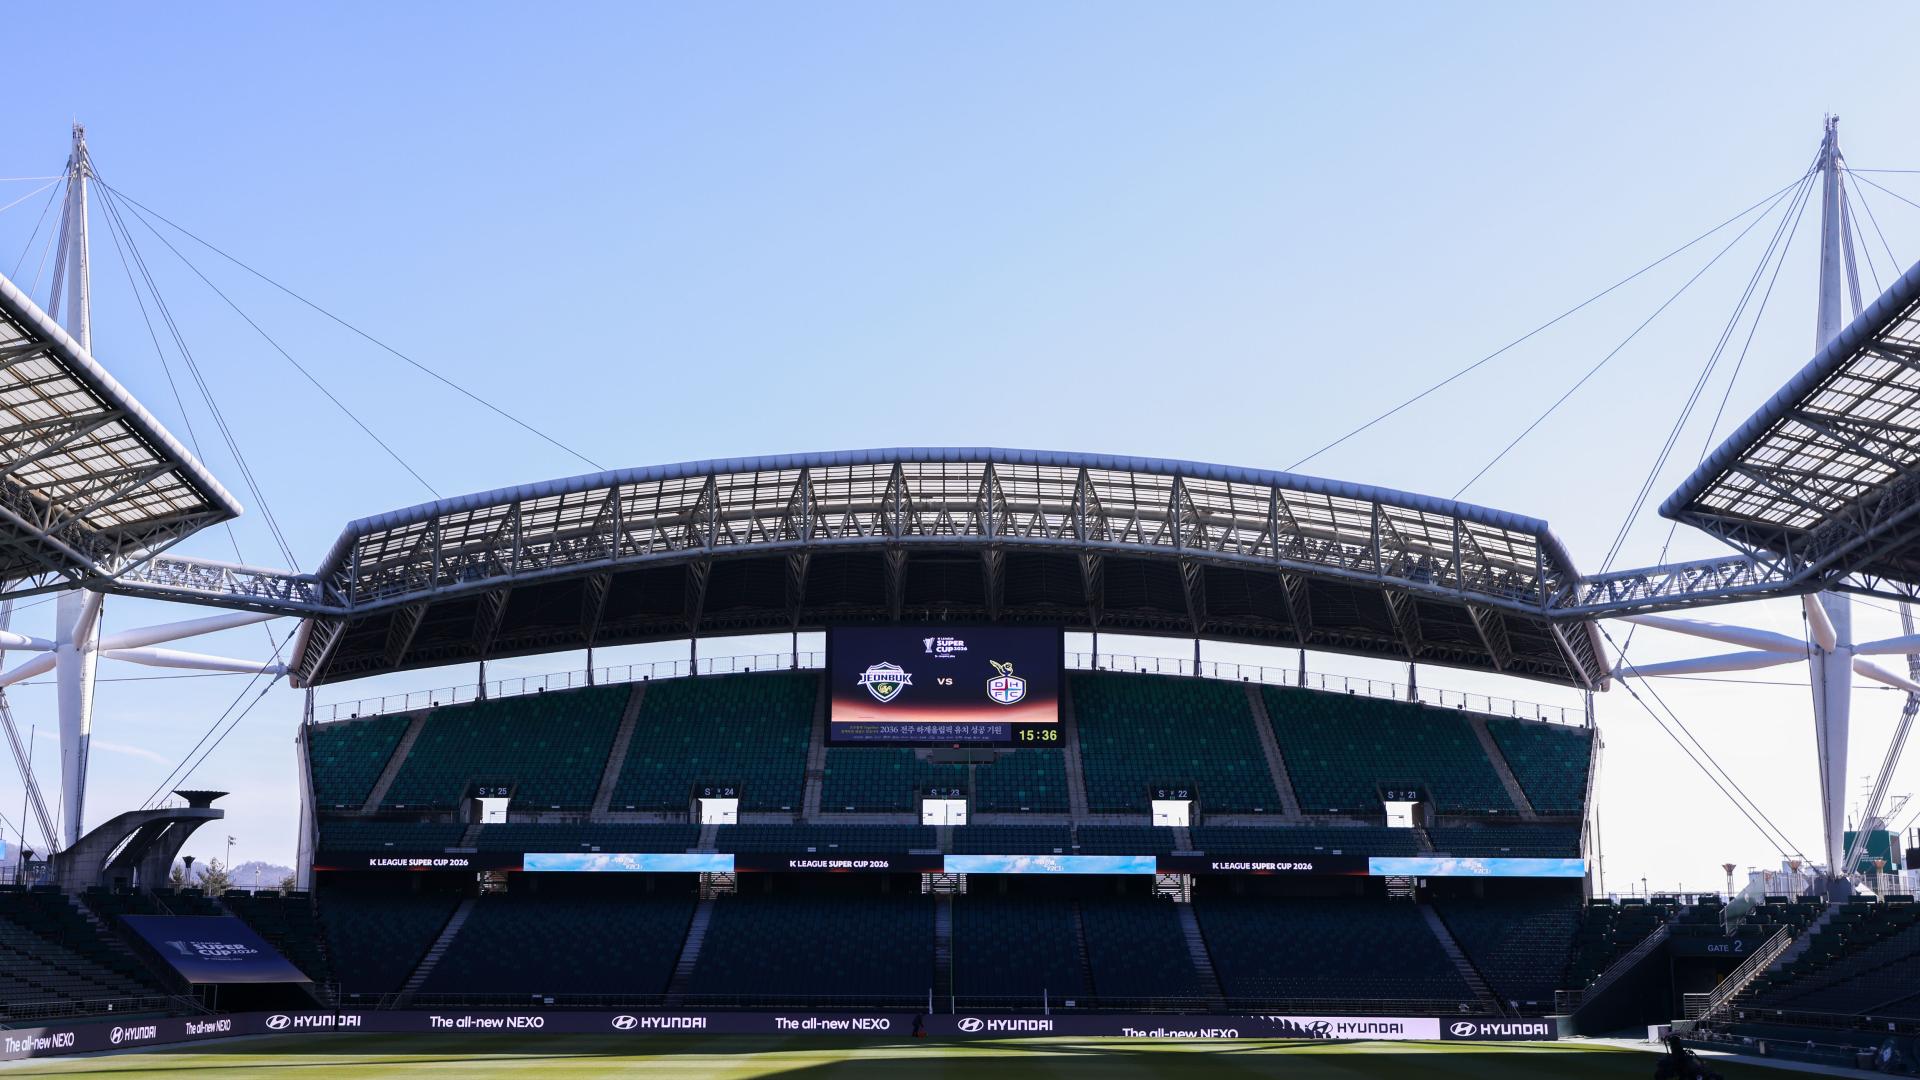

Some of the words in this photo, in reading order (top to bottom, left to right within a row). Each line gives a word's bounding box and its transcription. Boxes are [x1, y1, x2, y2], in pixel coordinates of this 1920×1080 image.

[863, 674, 909, 682] JEONBUK
[880, 725, 899, 734] 2036
[900, 725, 915, 735] 전주
[954, 725, 969, 735] 유치
[971, 725, 986, 735] 성공
[987, 725, 1002, 735] 기원
[1019, 729, 1057, 741] 15:36
[479, 787, 486, 795] S
[497, 787, 507, 795] 25
[704, 787, 711, 796] S
[724, 788, 734, 796] 24
[1158, 790, 1165, 798] S
[1178, 790, 1188, 798] 22
[1387, 791, 1394, 799] S
[1407, 791, 1416, 799] 21
[369, 858, 376, 866] K
[377, 858, 408, 866] LEAGUE
[408, 858, 432, 866] SUPER
[433, 858, 448, 866] CUP
[449, 858, 469, 866] 2026
[1212, 862, 1219, 870] K
[1220, 862, 1250, 870] LEAGUE
[1251, 862, 1276, 870] SUPER
[1276, 862, 1292, 870] CUP
[1293, 862, 1313, 870] 2026
[1707, 944, 1729, 952] GATE
[1733, 939, 1743, 952] 2
[185, 1022, 197, 1035] The
[196, 1020, 216, 1034] all-new
[216, 1019, 231, 1031] NEXO
[293, 1015, 361, 1027] HYUNDAI
[430, 1016, 454, 1028] The
[456, 1016, 504, 1028] all-new
[506, 1016, 544, 1028] NEXO
[641, 1017, 707, 1029] HYUNDAI
[775, 1017, 799, 1029] The
[801, 1017, 850, 1030] all-new
[852, 1018, 890, 1030] NEXO
[987, 1019, 1053, 1031] HYUNDAI
[124, 1025, 157, 1041] HYUNDAI
[1122, 1027, 1147, 1038] The
[1149, 1027, 1198, 1038] all-new
[1200, 1028, 1239, 1038] NEXO
[1337, 1022, 1404, 1034] HYUNDAI
[1480, 1023, 1548, 1035] HYUNDAI
[5, 1036, 20, 1053] The
[21, 1035, 52, 1051] all-new
[52, 1031, 75, 1048] NEXO
